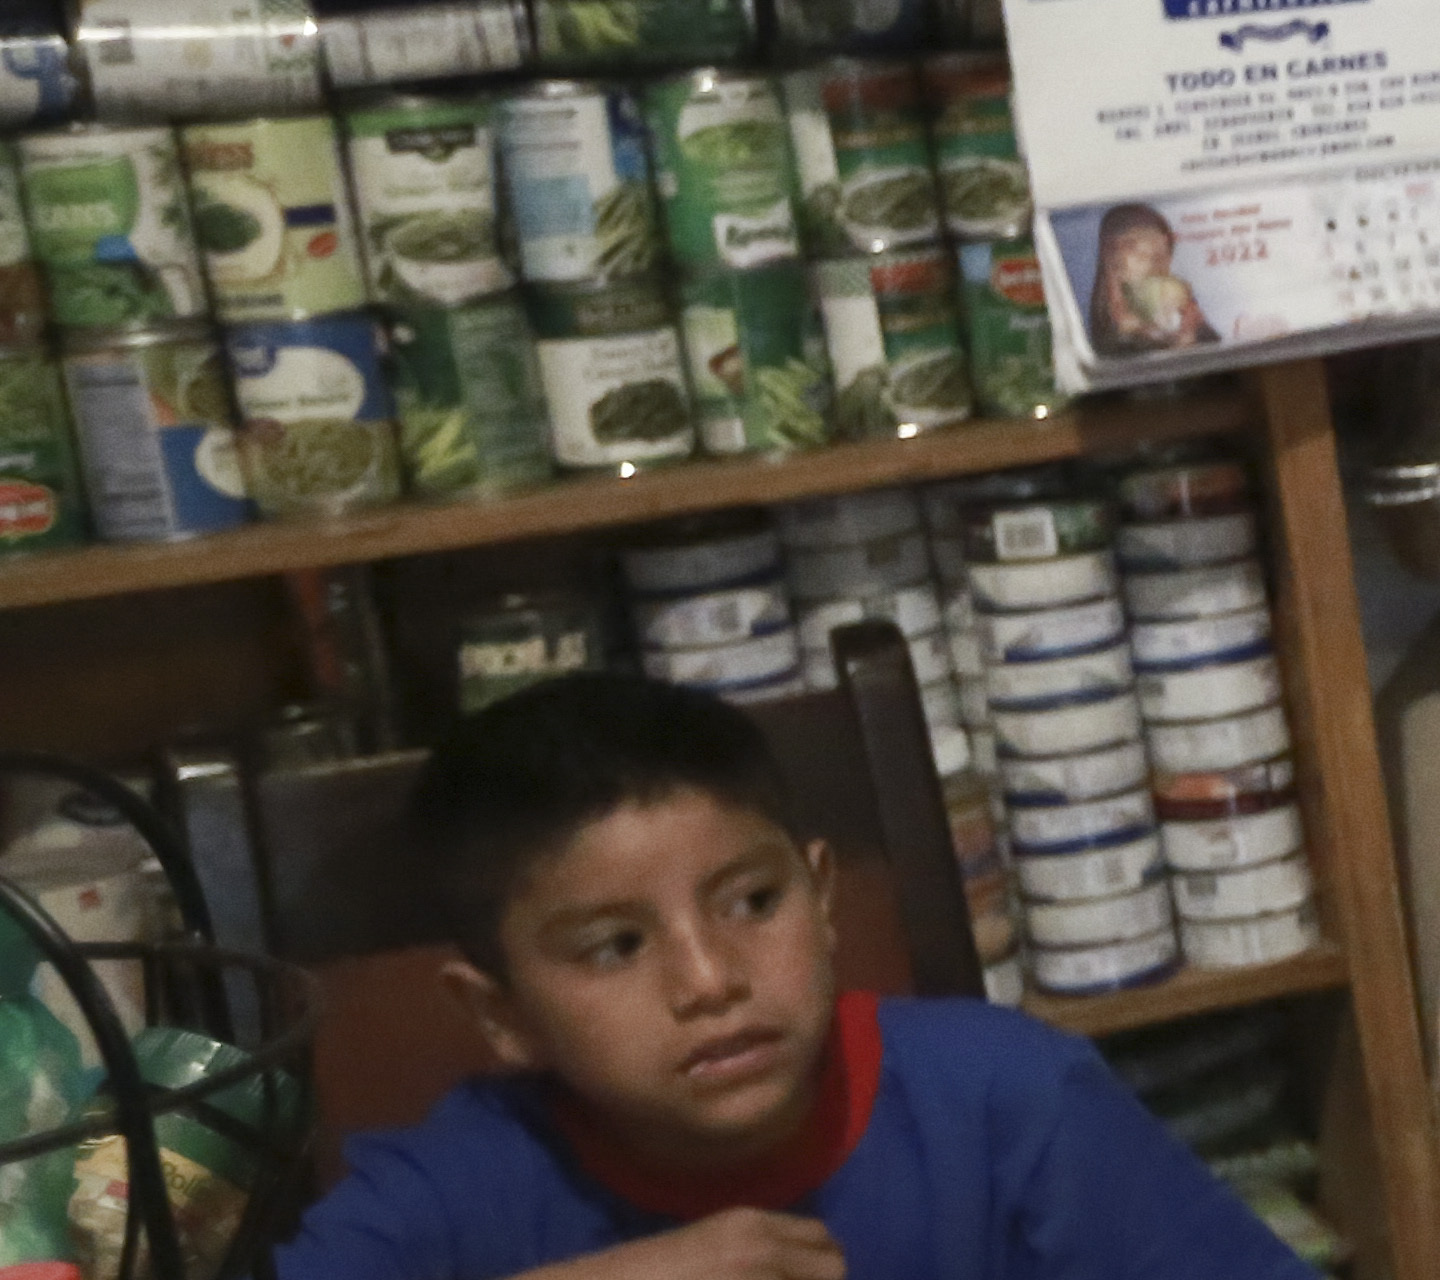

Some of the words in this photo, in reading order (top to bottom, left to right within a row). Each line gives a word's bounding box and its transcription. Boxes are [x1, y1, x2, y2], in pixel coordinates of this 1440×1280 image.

[1165, 69, 1235, 94] TODO
[1244, 64, 1278, 84] EN
[1286, 51, 1388, 79] CARNES
